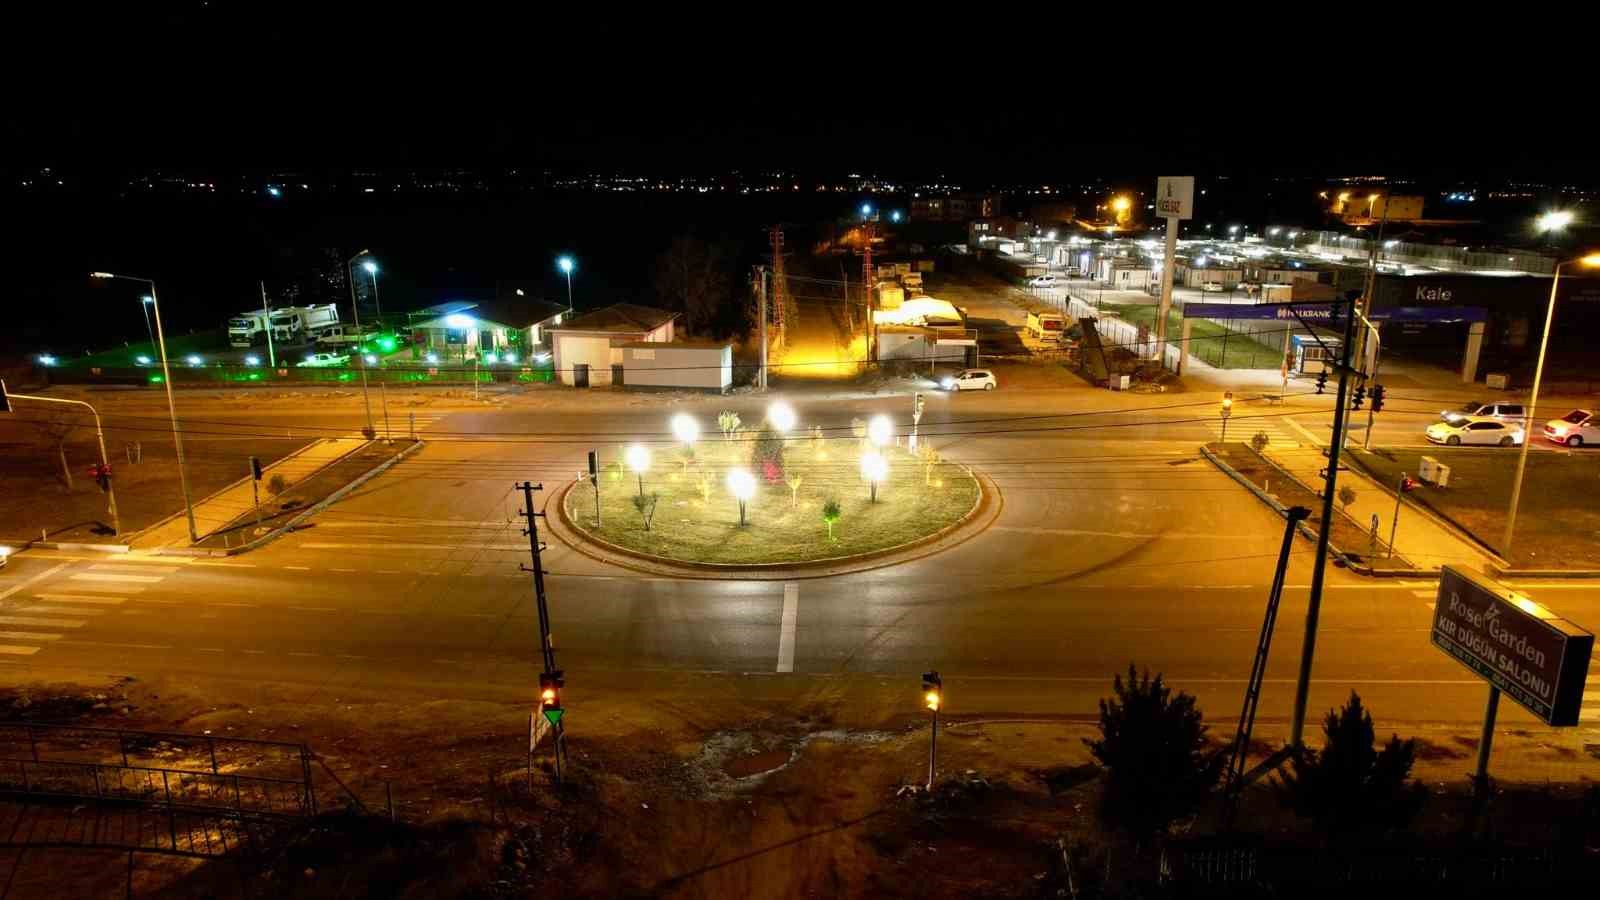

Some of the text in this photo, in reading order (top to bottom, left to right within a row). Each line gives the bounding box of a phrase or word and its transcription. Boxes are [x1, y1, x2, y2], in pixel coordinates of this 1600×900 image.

[1415, 285, 1452, 301] Kale
[1438, 616, 1456, 637] KIR
[1497, 653, 1551, 698] SALONU
[1450, 592, 1482, 628] Rose
[1489, 617, 1545, 669] Garden
